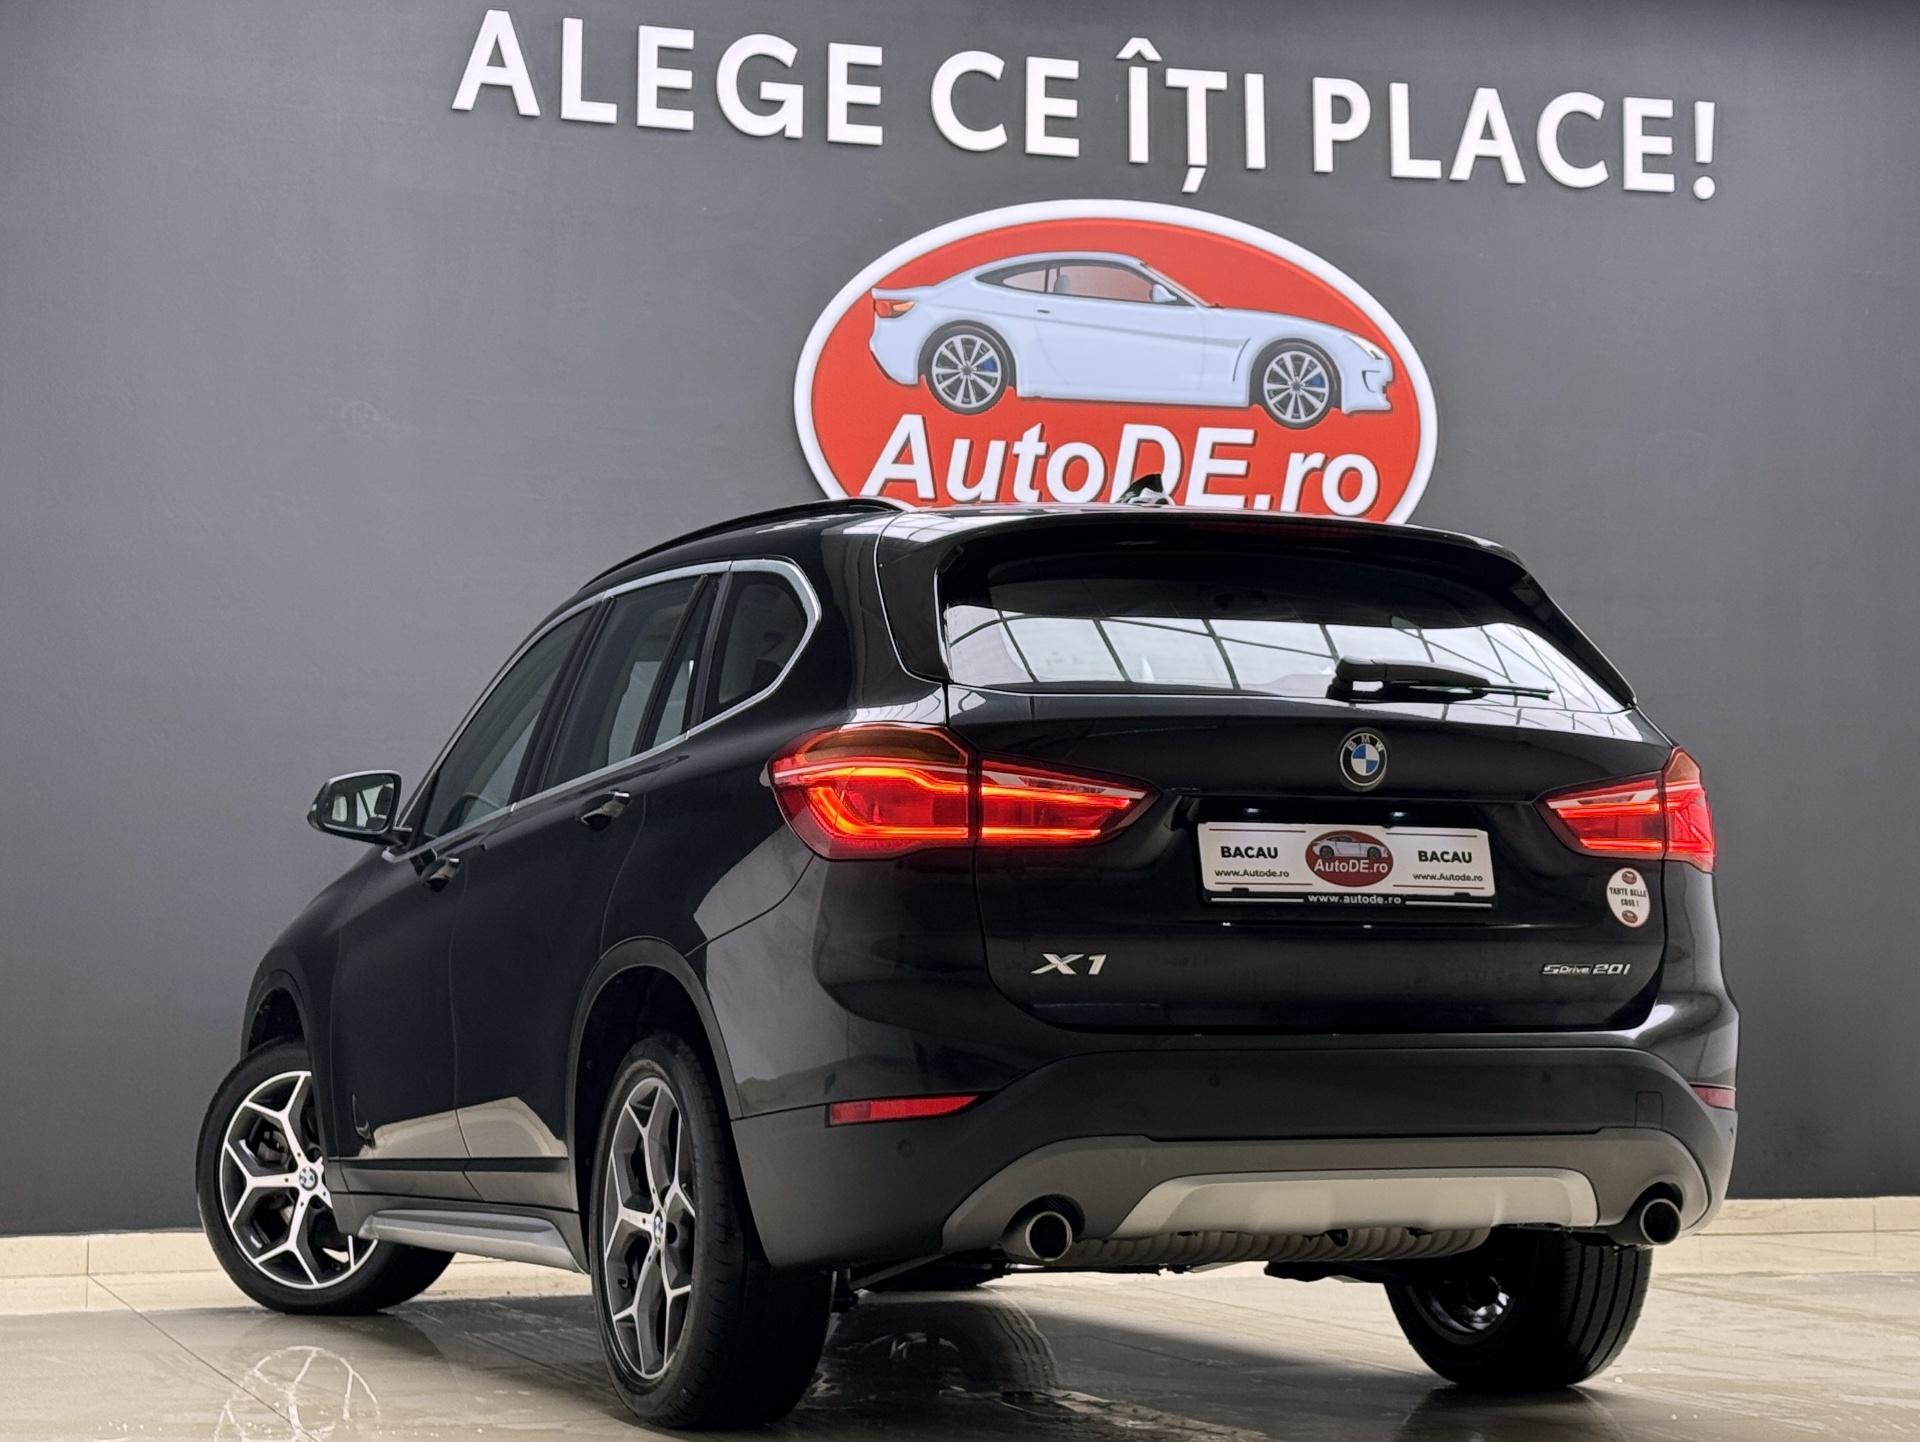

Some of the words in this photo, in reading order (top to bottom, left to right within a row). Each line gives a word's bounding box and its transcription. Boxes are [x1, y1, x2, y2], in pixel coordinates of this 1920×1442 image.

[451, 9, 883, 146] ALEGE
[930, 50, 1080, 158] CE
[1312, 76, 1716, 201] PLACE!
[859, 413, 1380, 517] AutoDE.ro
[1346, 734, 1385, 753] BMW
[1220, 845, 1279, 859] BACAU
[1417, 850, 1473, 863] BACAU
[1214, 868, 1290, 878] www.Autode.ro
[1313, 858, 1389, 874] AutoDE.ro
[1412, 872, 1484, 882] www.Autode.ro
[1308, 894, 1402, 904] www.autode.ro
[1030, 953, 1107, 975] X1
